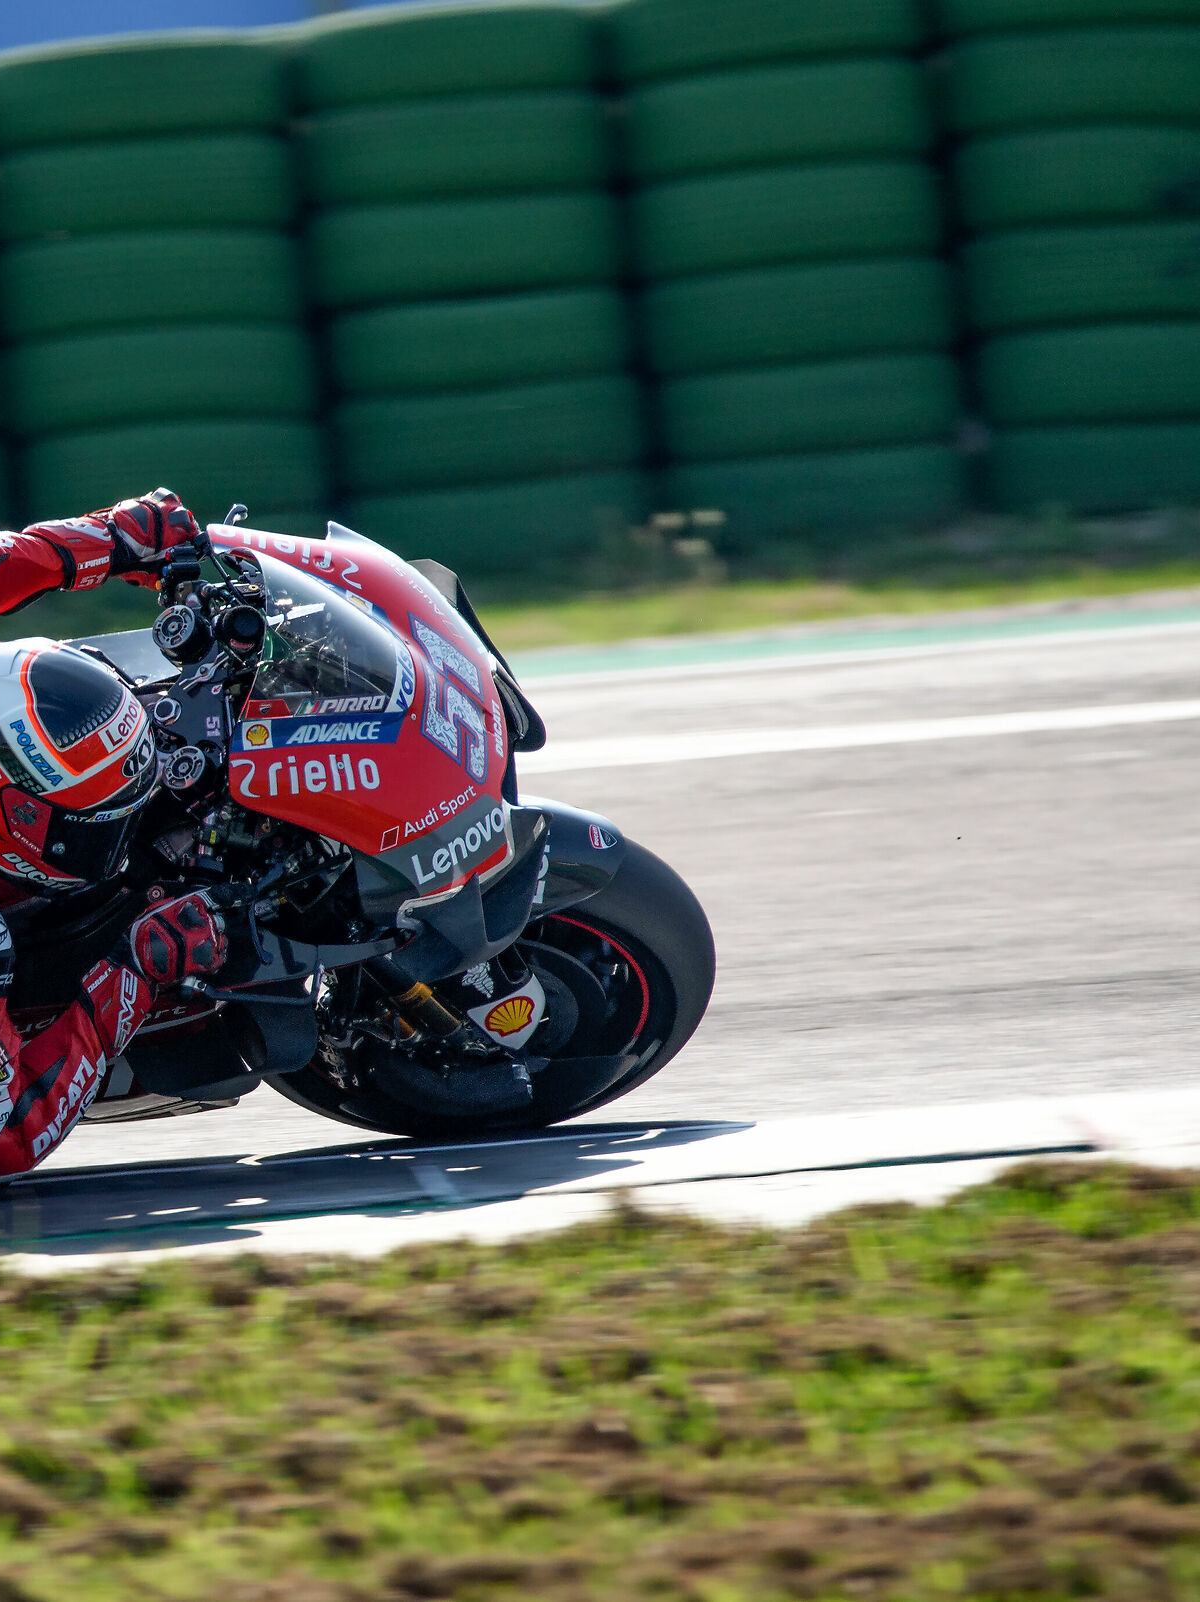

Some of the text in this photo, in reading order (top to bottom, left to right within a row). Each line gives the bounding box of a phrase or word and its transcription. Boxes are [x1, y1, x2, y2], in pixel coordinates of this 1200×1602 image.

[206, 716, 220, 737] 51
[318, 695, 386, 714] PIRRO
[10, 719, 63, 787] POLIZIA
[285, 721, 382, 745] ADVANCE
[267, 753, 381, 797] riello
[403, 785, 477, 838] Audi Sport
[411, 807, 505, 886] Lenovo
[33, 1055, 96, 1158] DUCATI
